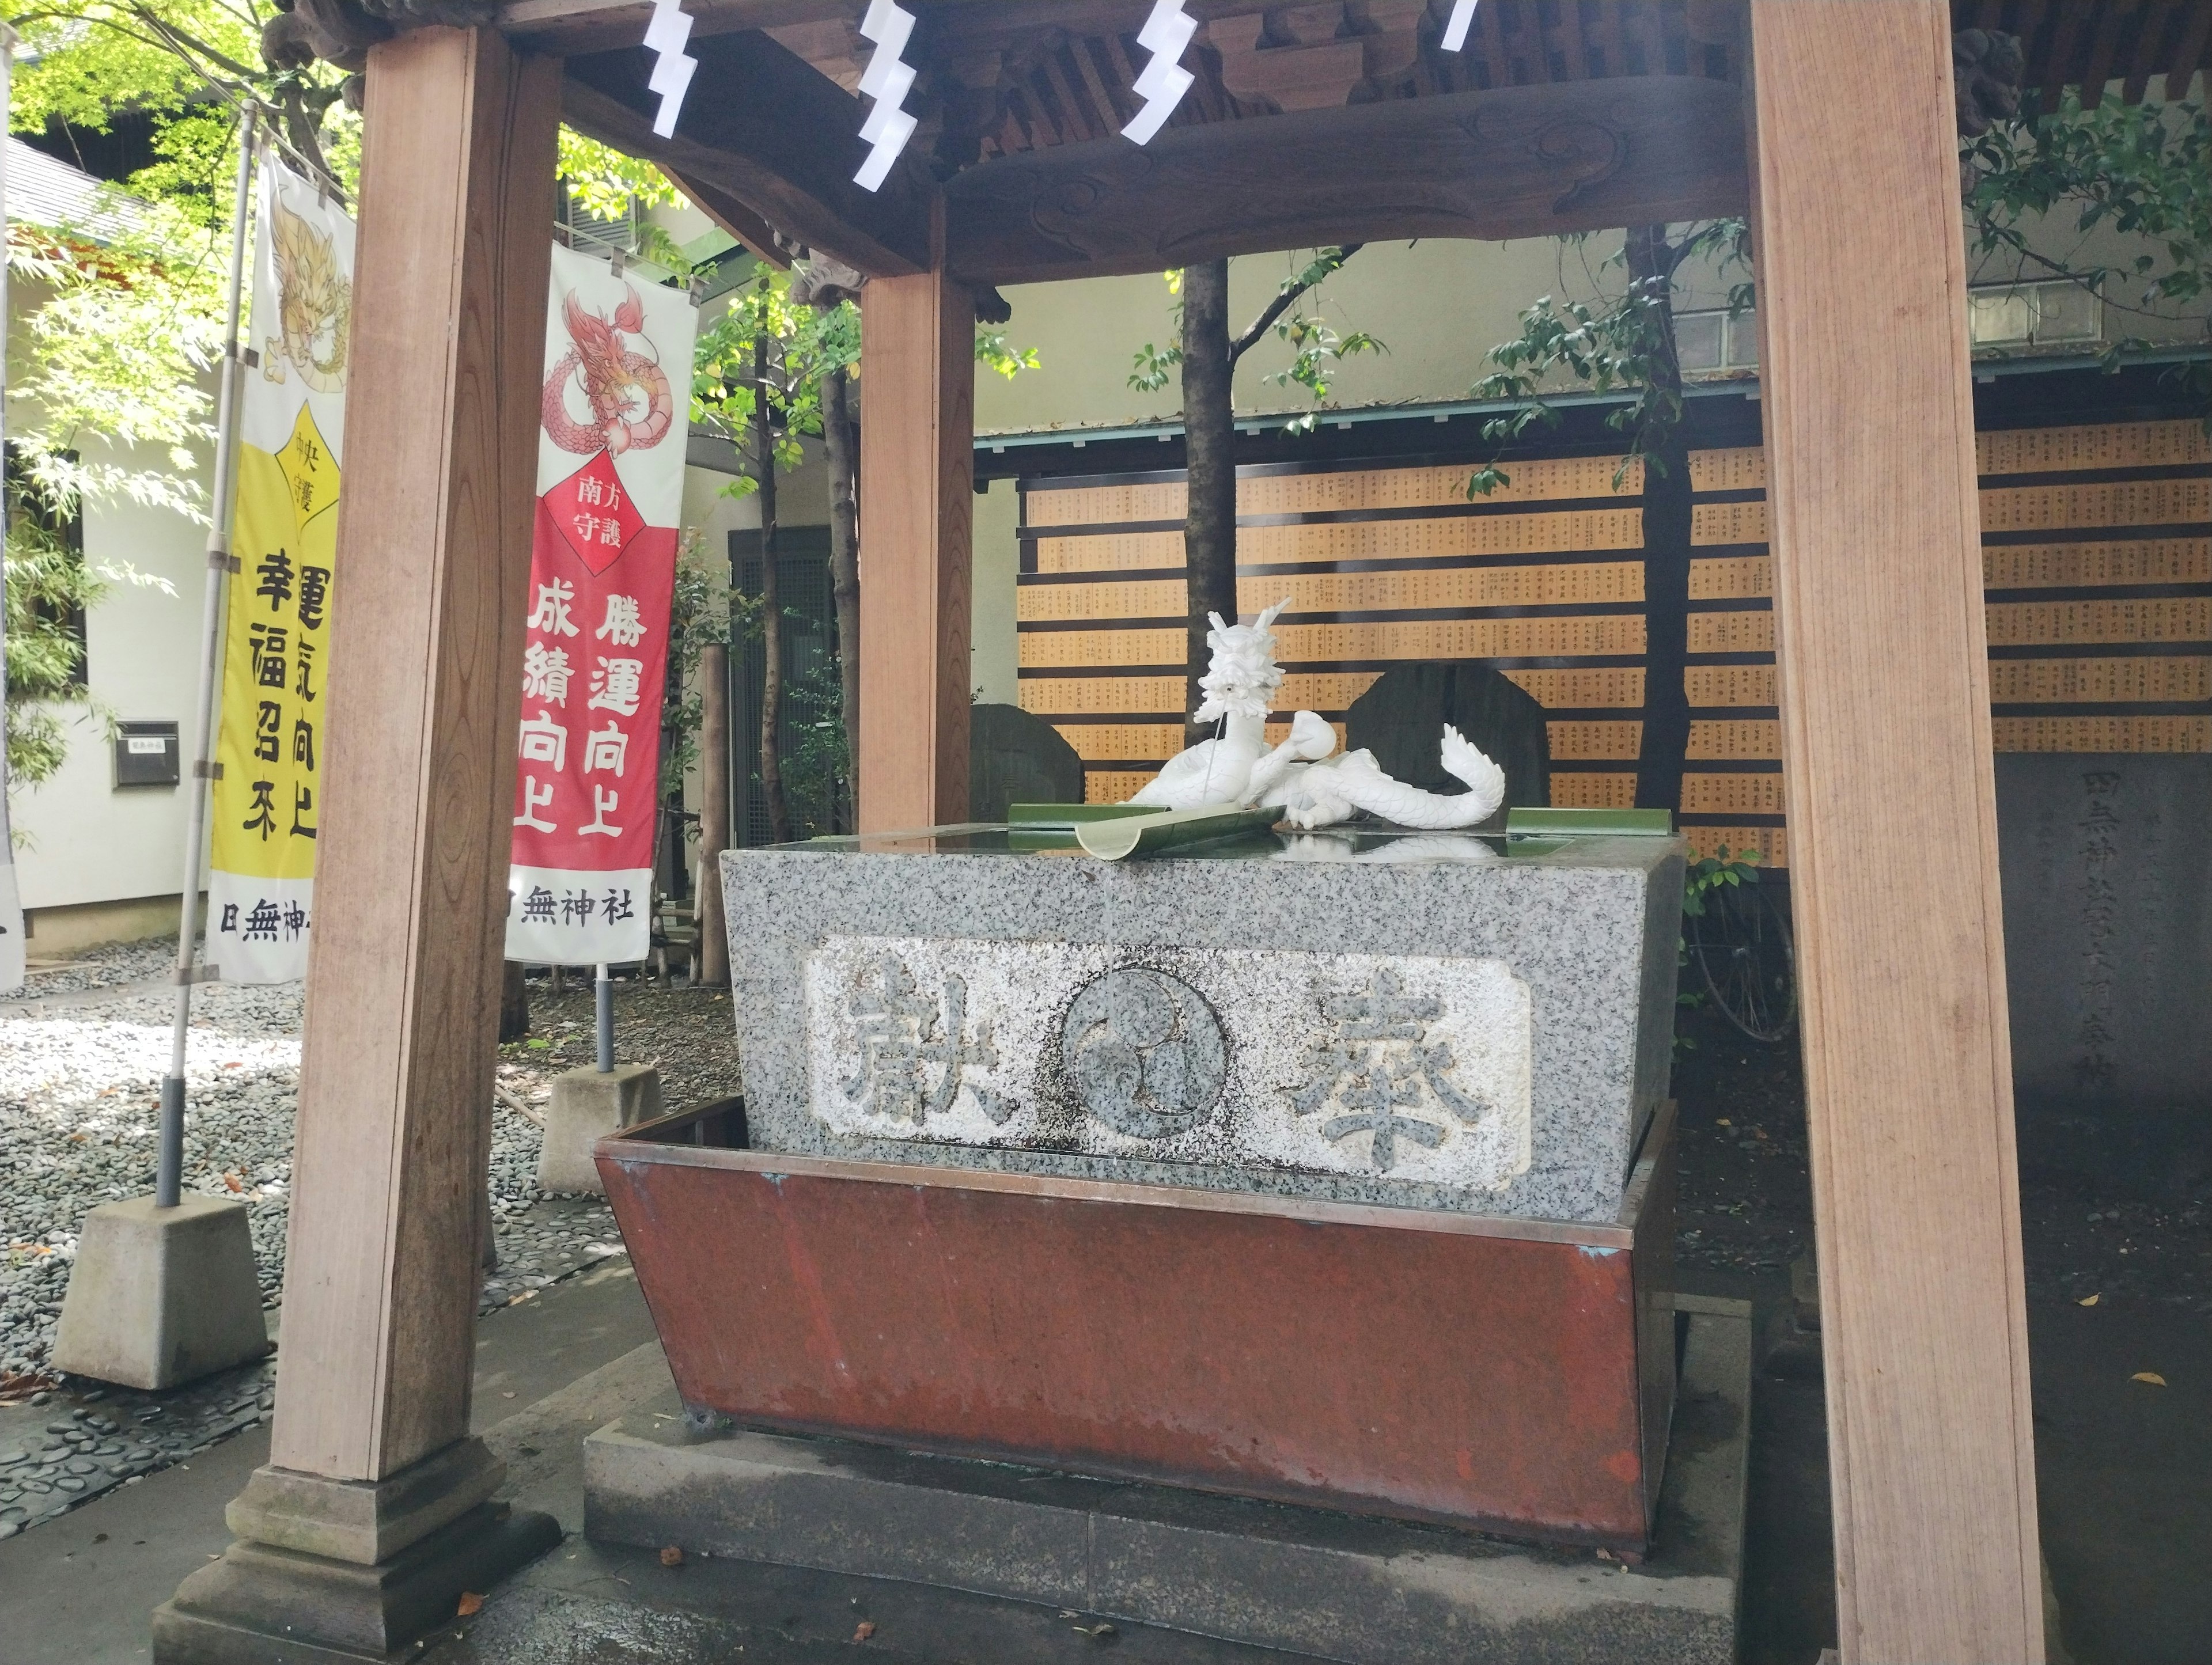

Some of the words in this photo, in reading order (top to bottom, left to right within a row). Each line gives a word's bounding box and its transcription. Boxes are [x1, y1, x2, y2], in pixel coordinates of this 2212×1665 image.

[578, 475, 621, 511] 南方
[573, 512, 621, 548] 守護
[513, 576, 581, 833] 成績向上
[578, 594, 648, 837] 勝運向上
[509, 885, 634, 927] 無神社
